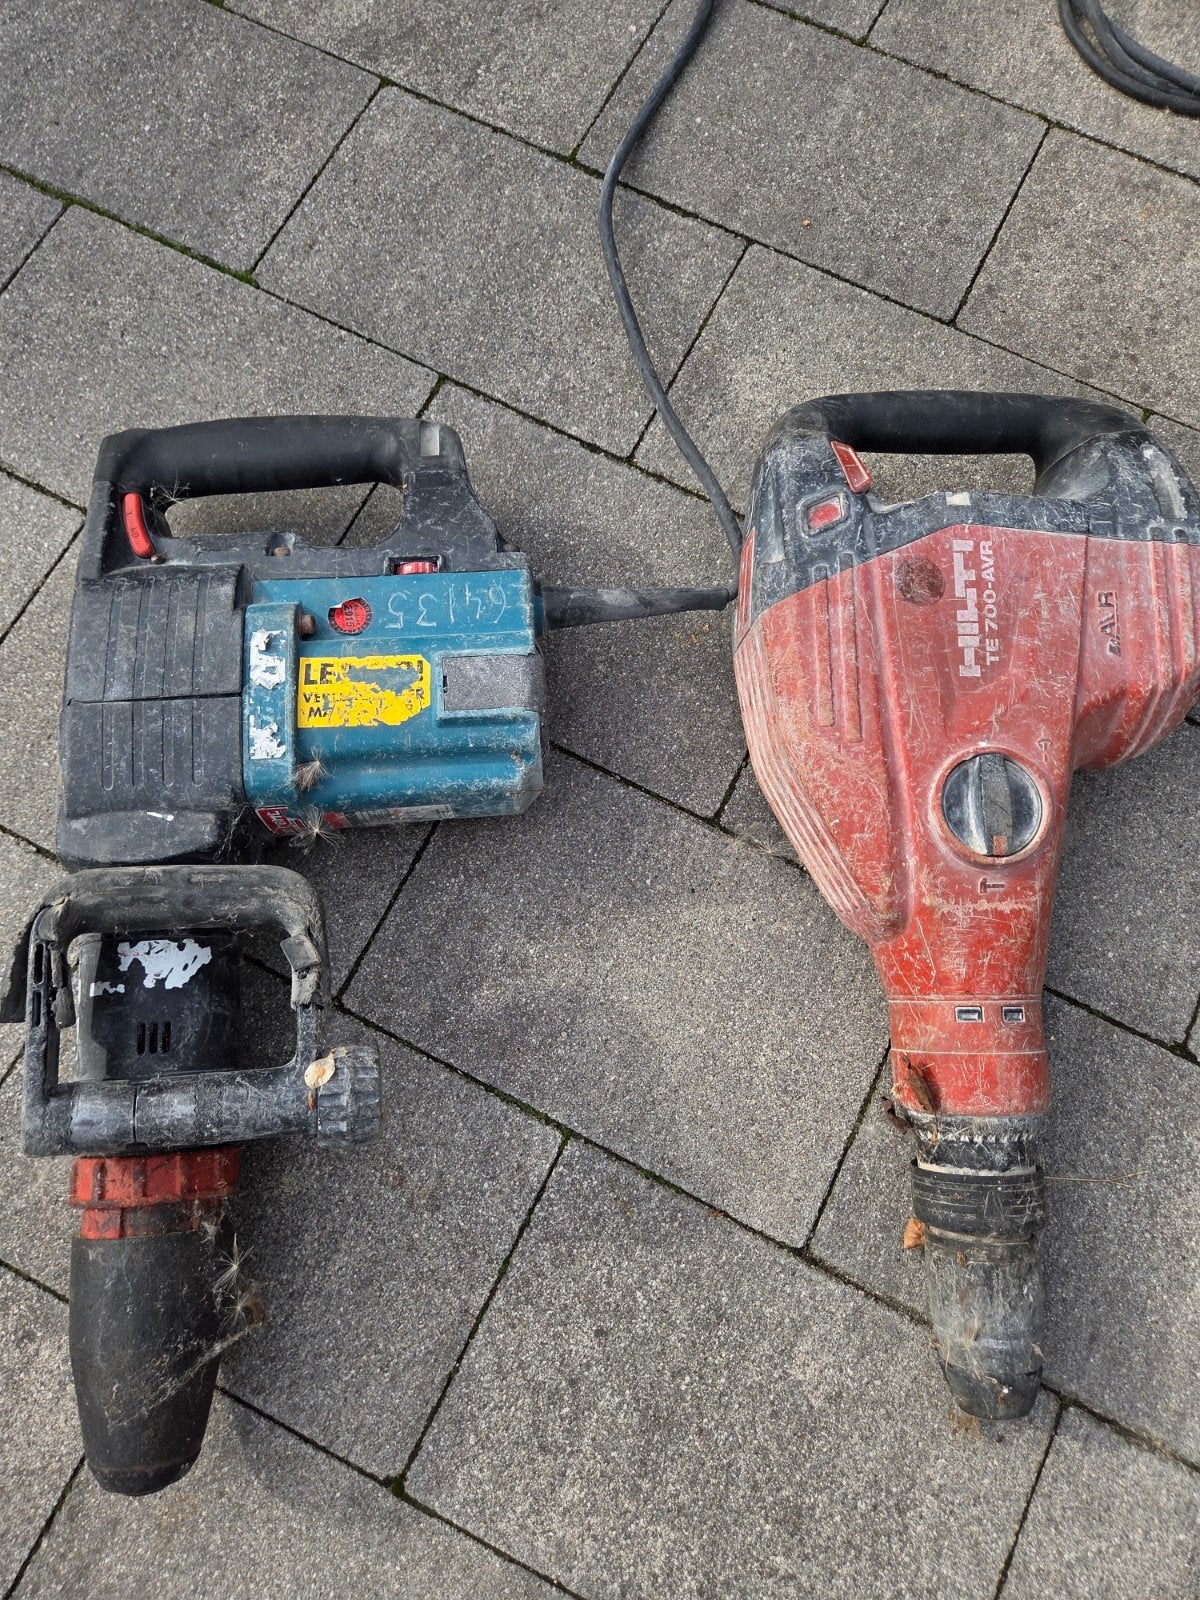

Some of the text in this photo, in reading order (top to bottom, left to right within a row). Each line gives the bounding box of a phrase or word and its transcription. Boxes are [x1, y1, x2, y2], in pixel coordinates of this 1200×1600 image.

[952, 539, 981, 677] HILTI
[979, 540, 999, 666] TE 700-AVR
